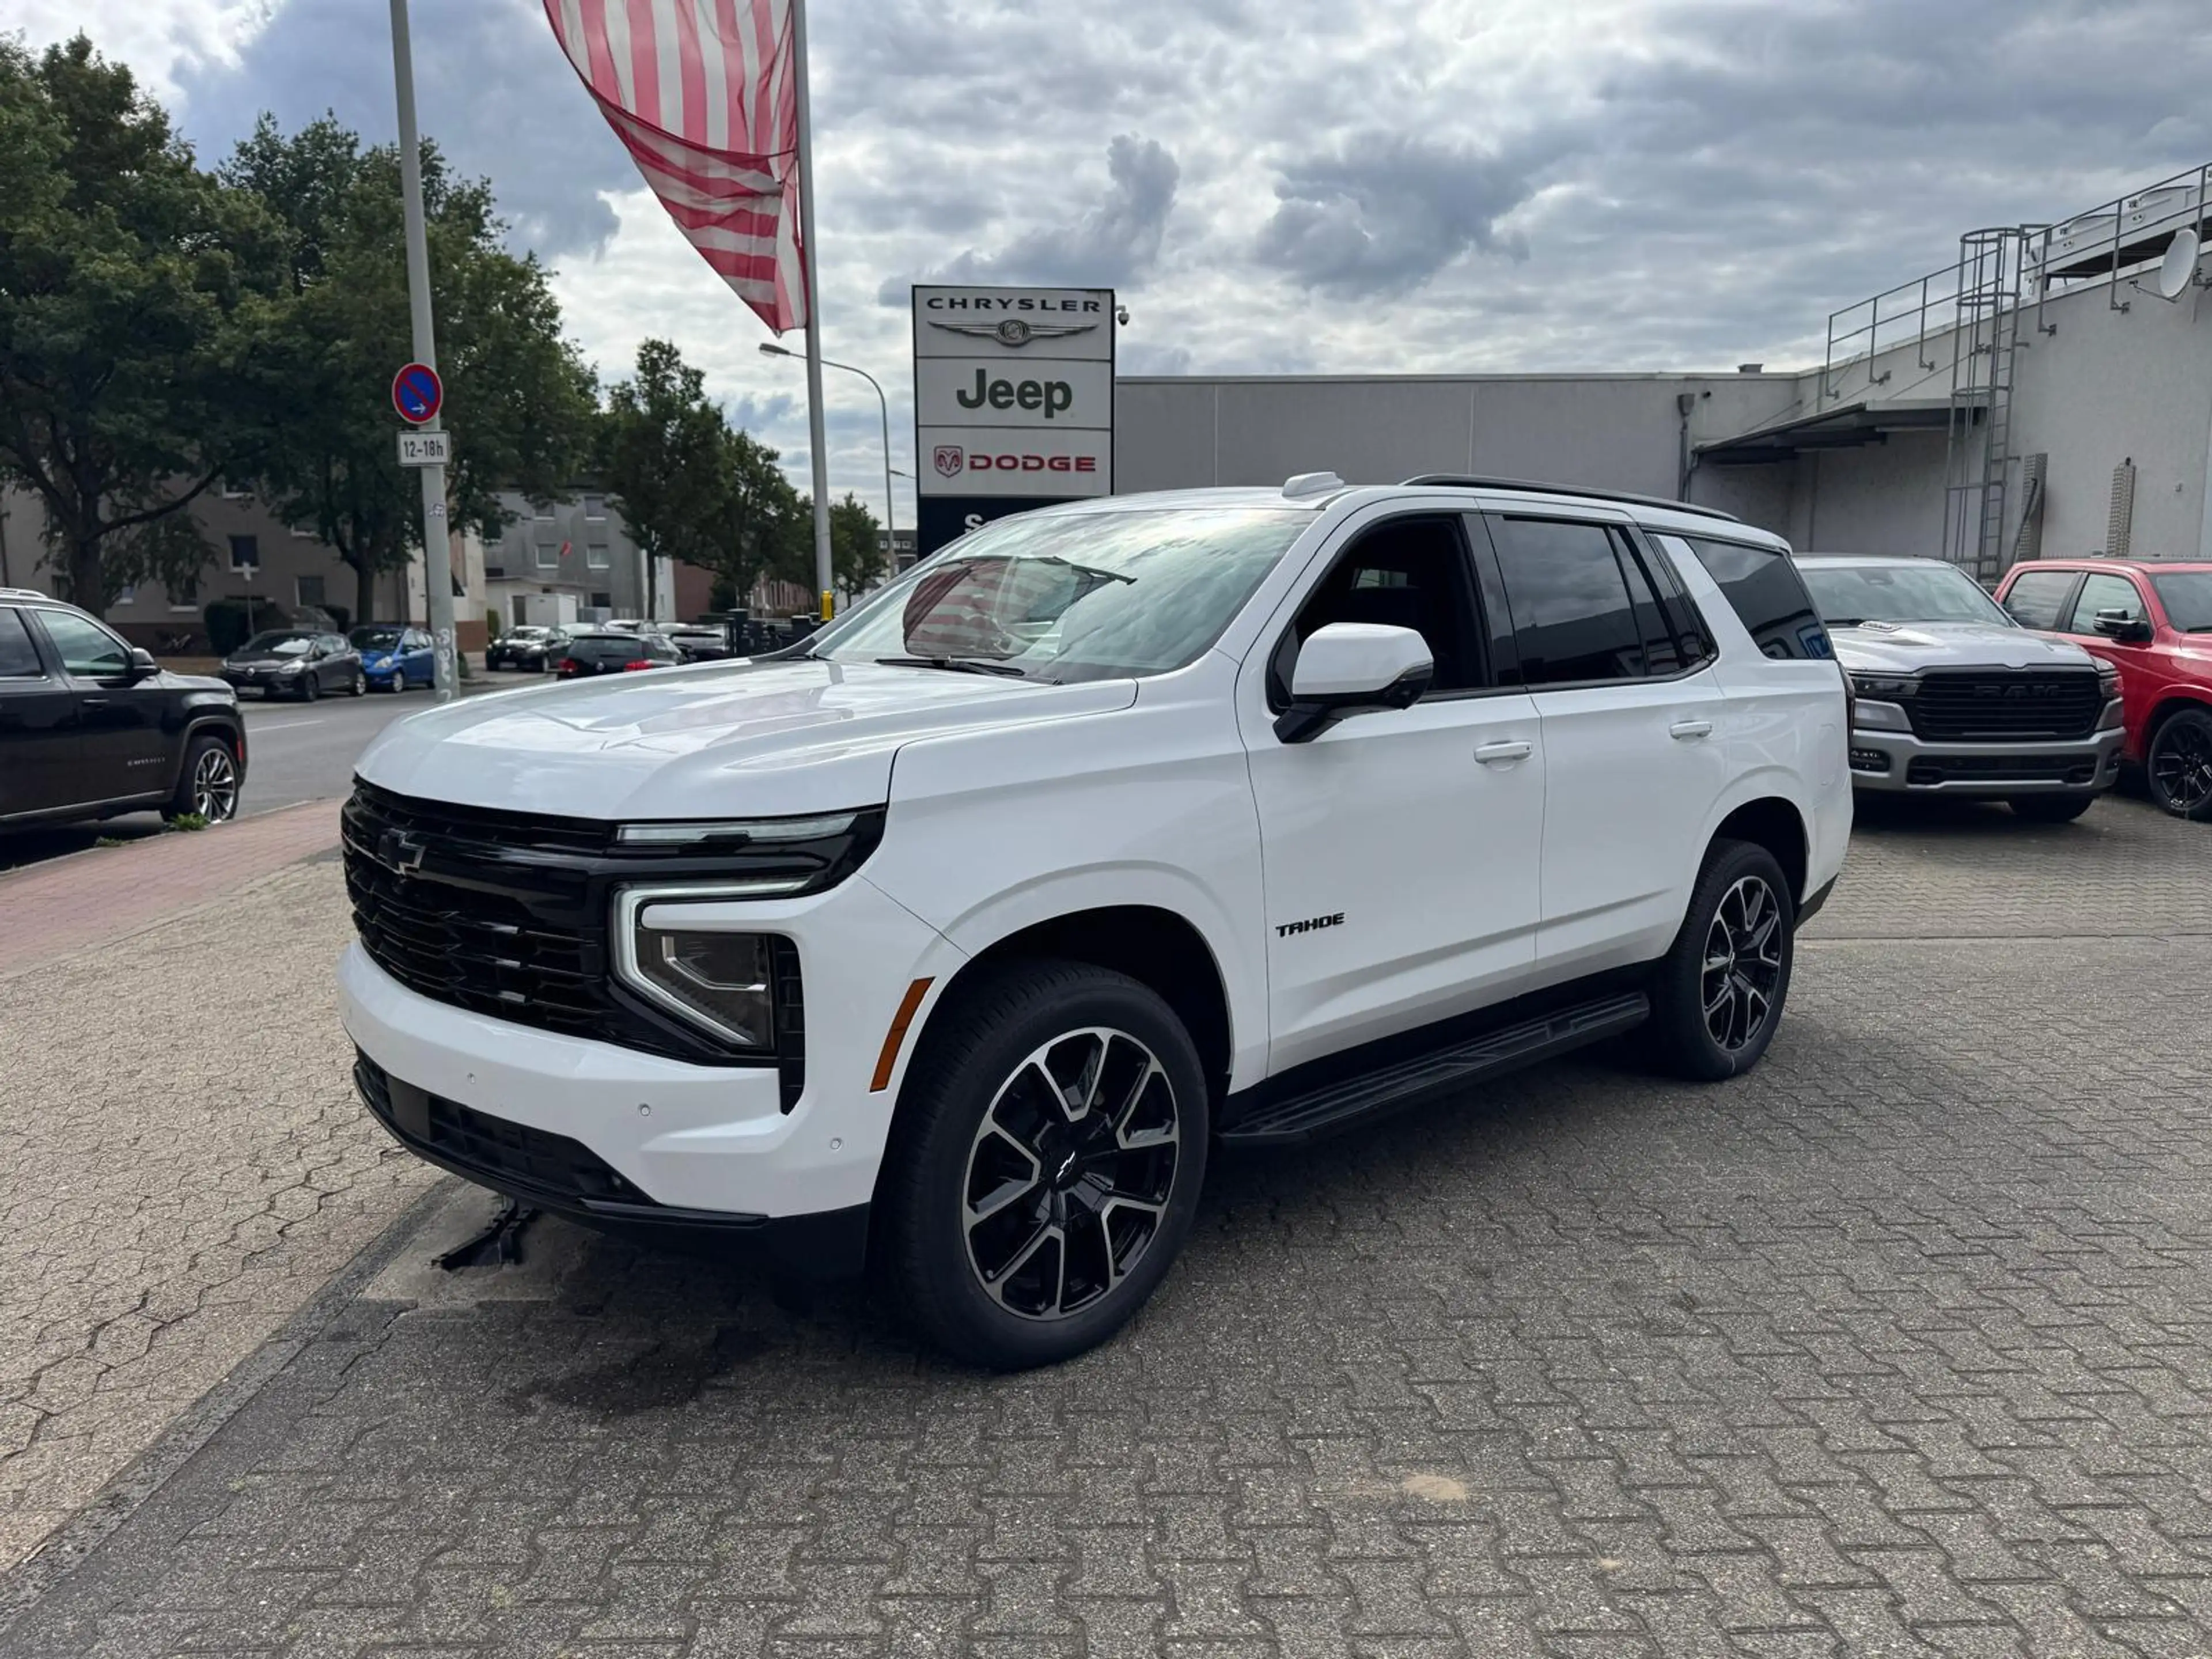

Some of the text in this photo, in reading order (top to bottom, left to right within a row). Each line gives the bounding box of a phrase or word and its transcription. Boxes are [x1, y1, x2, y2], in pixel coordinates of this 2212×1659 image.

[927, 298, 1100, 312] CHRYSLER
[957, 369, 1072, 419] Jeep
[404, 440, 444, 457] 12-18h
[969, 454, 1096, 472] DODGE
[1974, 685, 2061, 697] RAM
[1275, 912, 1345, 938] TAHOE
